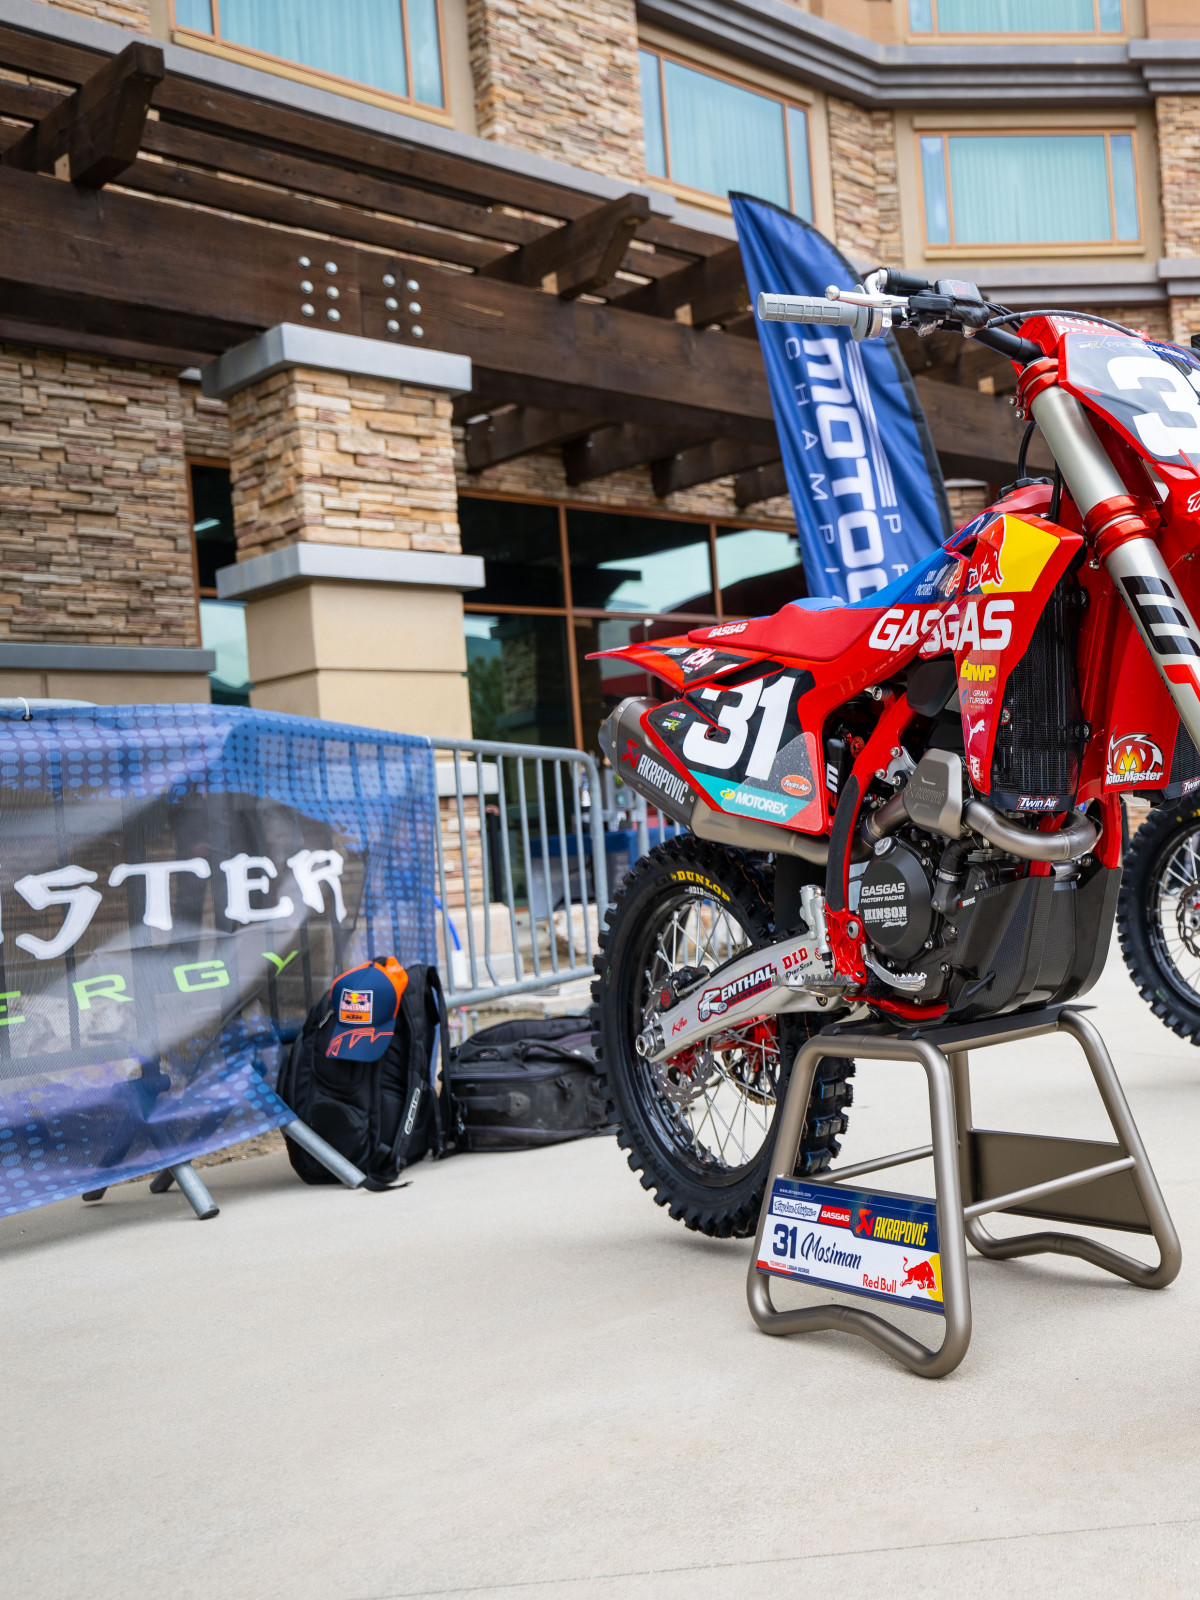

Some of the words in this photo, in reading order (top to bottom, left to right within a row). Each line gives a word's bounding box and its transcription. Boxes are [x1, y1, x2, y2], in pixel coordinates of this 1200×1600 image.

[785, 336, 845, 602] CHAMPI
[707, 622, 749, 639] GASGAS
[868, 599, 1015, 654] GASGAS
[683, 664, 797, 782] 31
[735, 792, 789, 816] MOTOREX
[1020, 797, 1042, 808] Twin
[1043, 798, 1058, 808] Air
[676, 870, 731, 902] DUNLOP
[861, 882, 906, 897] GASGAS
[0, 849, 347, 960] STER
[864, 906, 908, 921] HINSON
[821, 1210, 850, 1222] GASGAS
[772, 1223, 798, 1260] 31
[801, 1231, 862, 1270] Mosiman
[862, 1273, 879, 1290] Red
[880, 1276, 897, 1294] Bull
